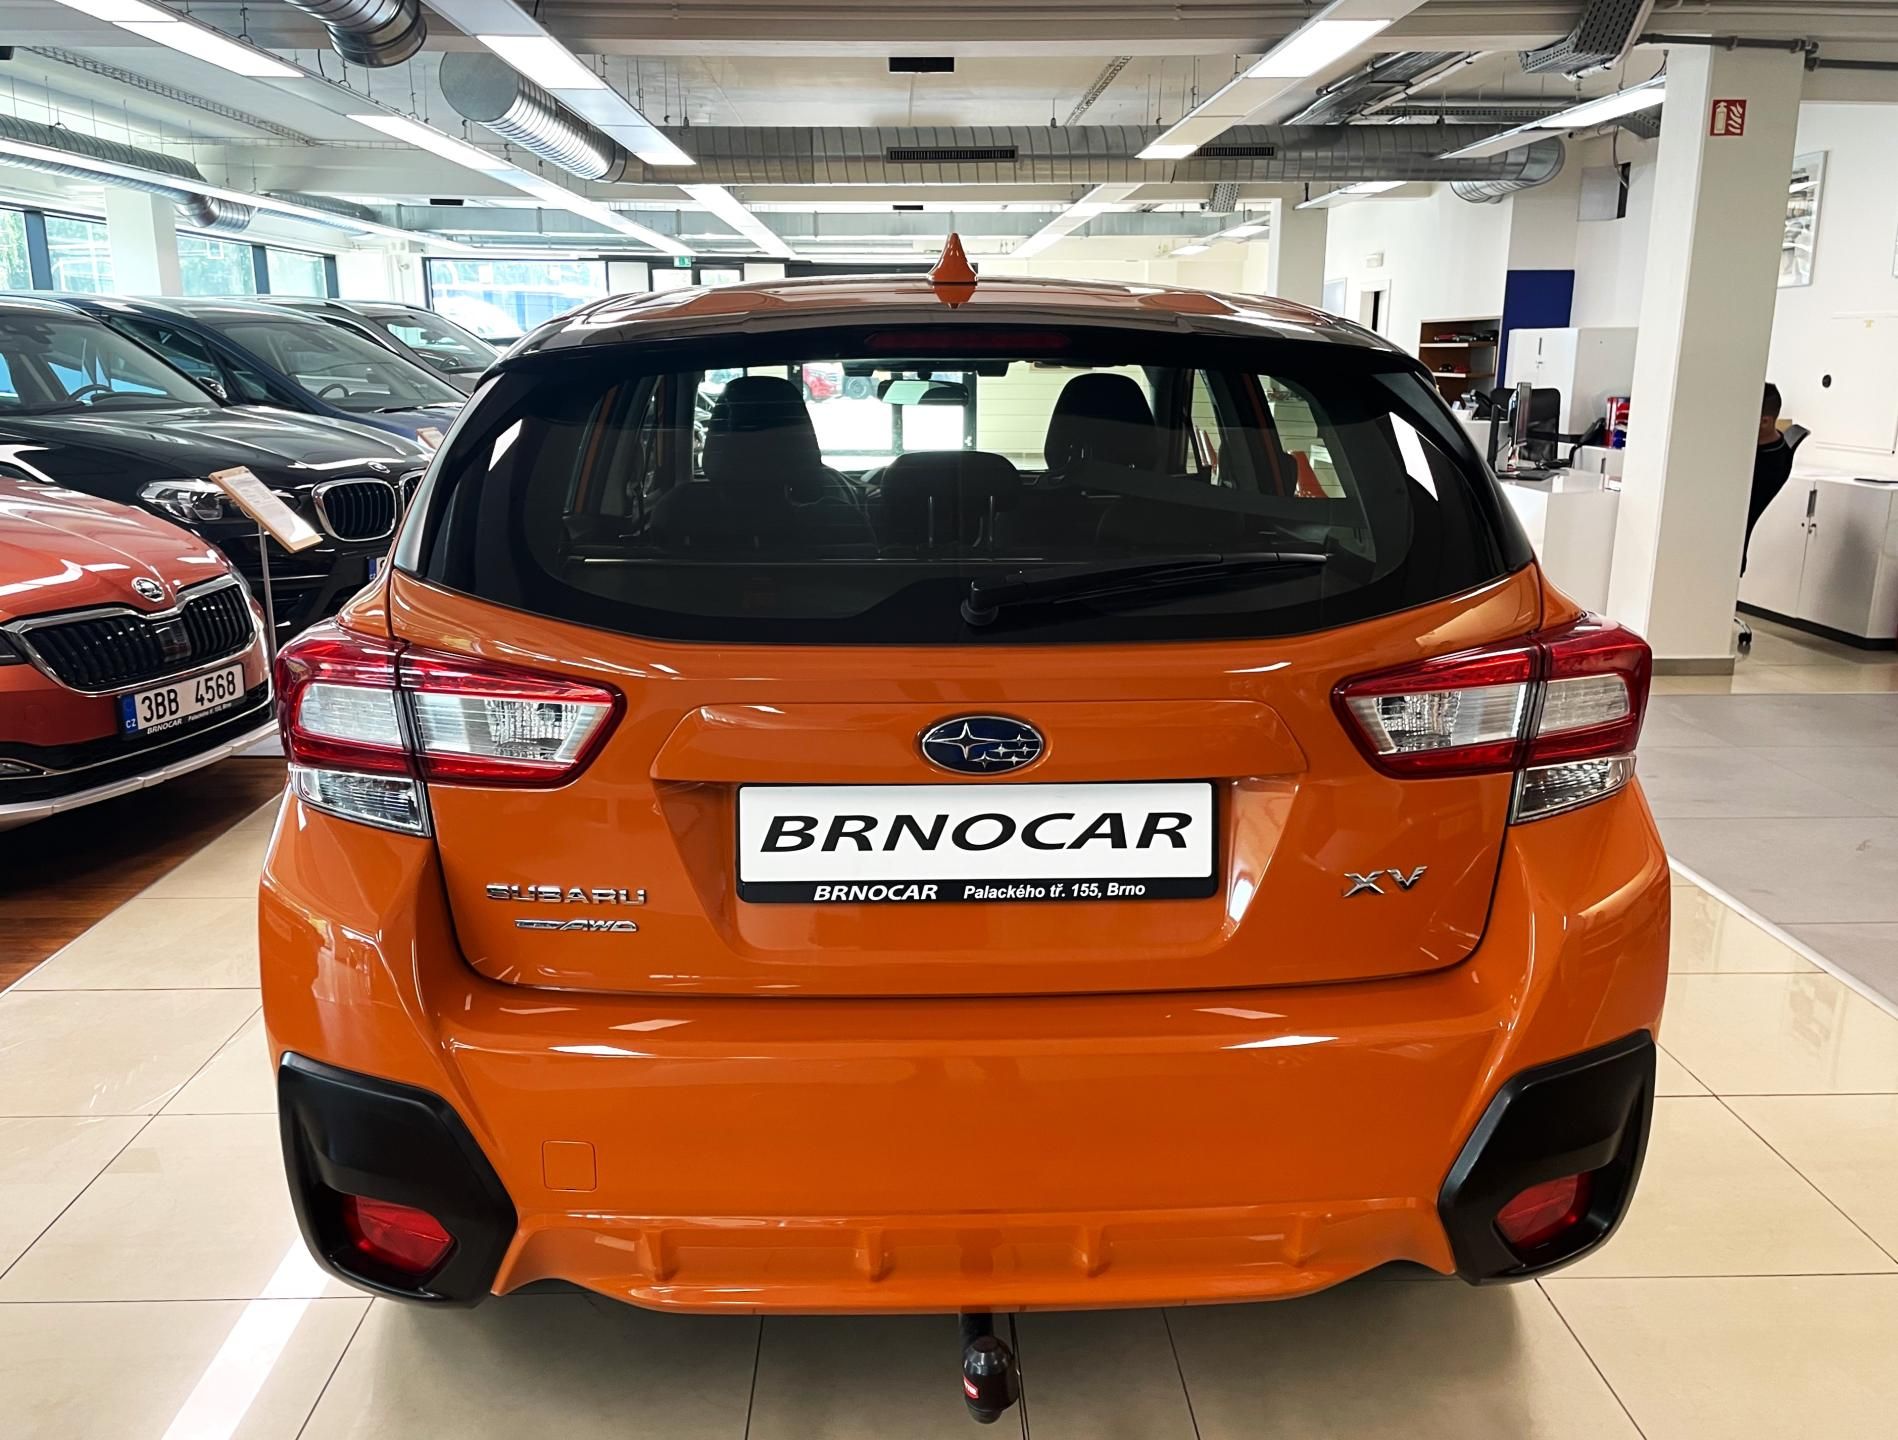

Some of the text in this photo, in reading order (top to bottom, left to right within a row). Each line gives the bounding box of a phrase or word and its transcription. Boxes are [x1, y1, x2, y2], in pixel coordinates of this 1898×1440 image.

[141, 688, 180, 723] 3BB
[194, 671, 236, 706] 4568
[125, 718, 137, 729] CZ
[146, 718, 183, 735] BRNOCAR
[759, 811, 1194, 853] BRNOCAR
[812, 882, 1147, 901] BRNOCAR Palackého tř. 155, Brno
[1342, 865, 1428, 898] XV
[486, 883, 646, 906] SUBARU
[559, 918, 639, 932] AWD
